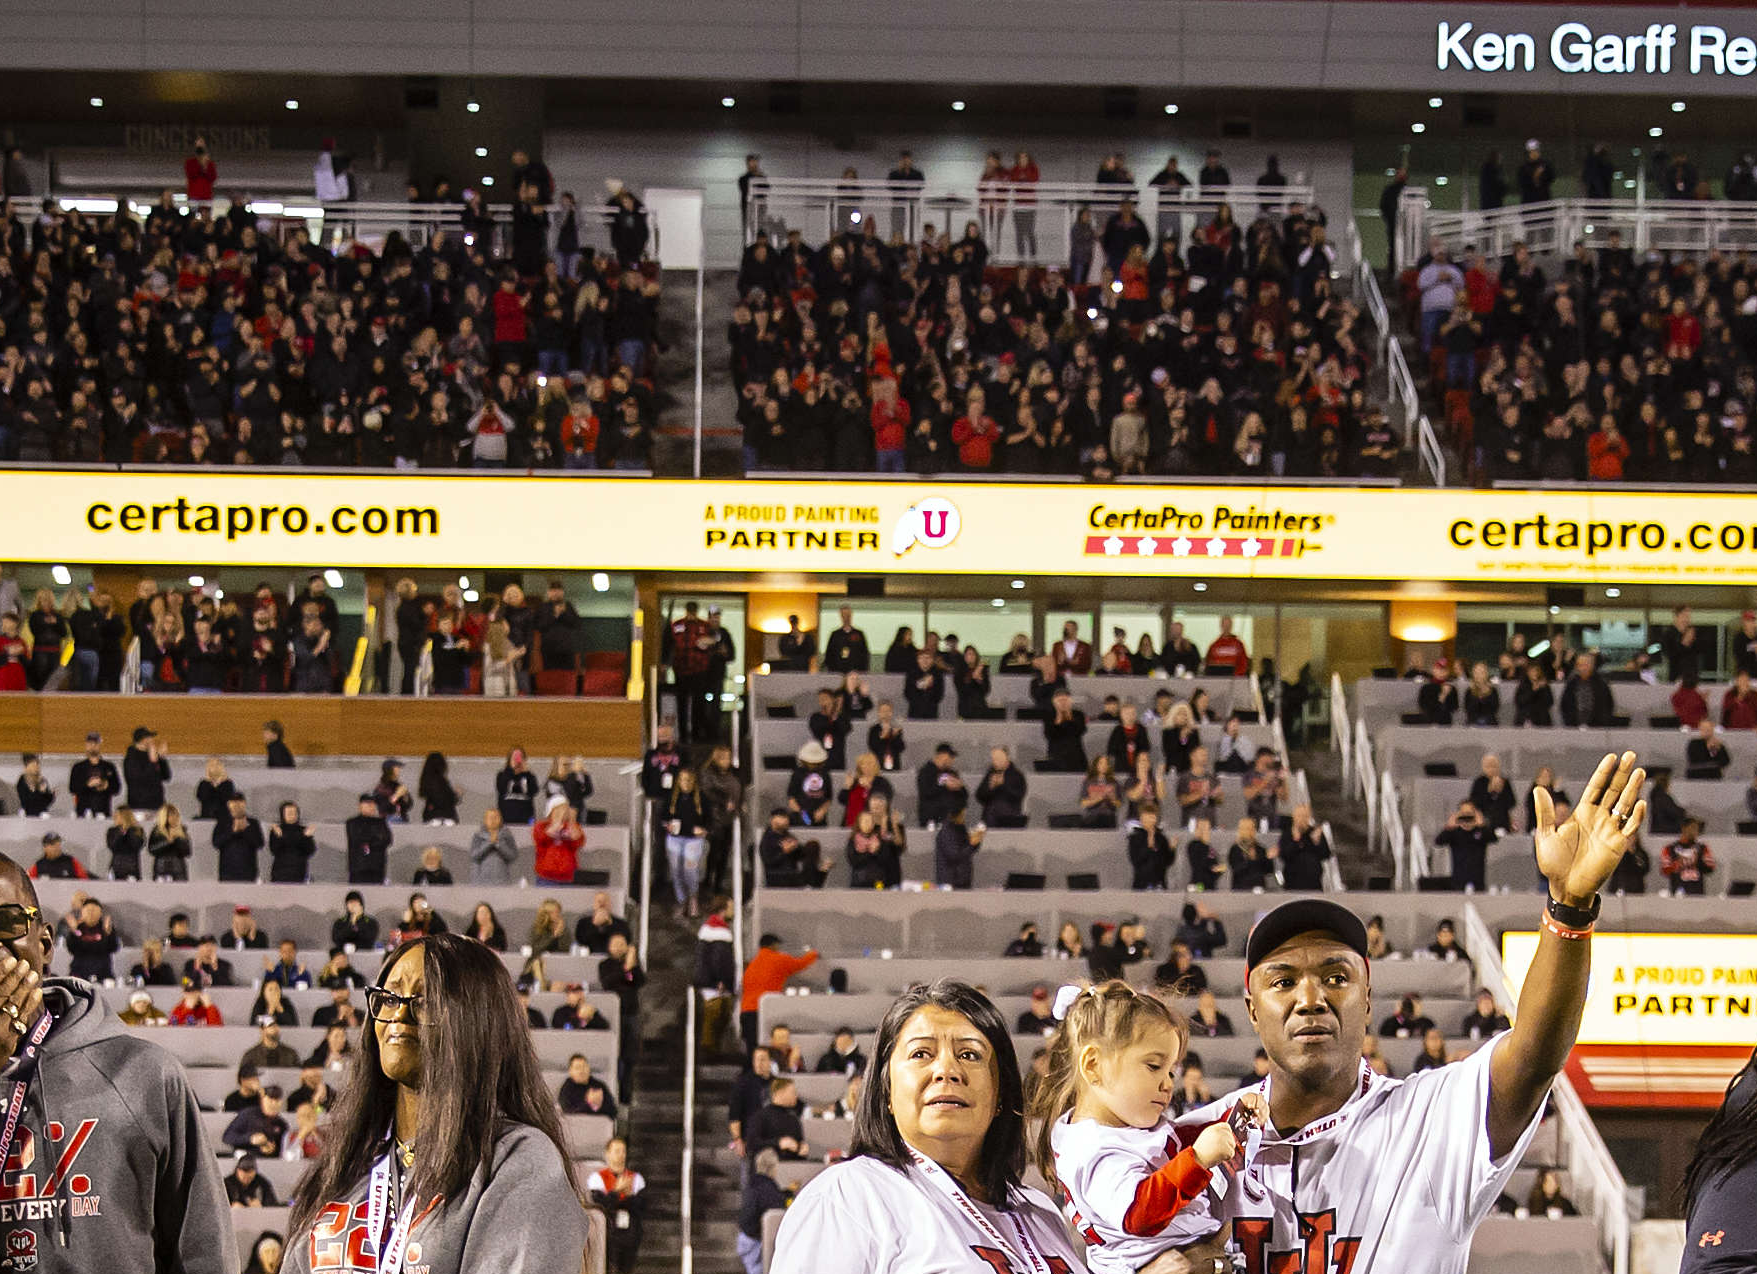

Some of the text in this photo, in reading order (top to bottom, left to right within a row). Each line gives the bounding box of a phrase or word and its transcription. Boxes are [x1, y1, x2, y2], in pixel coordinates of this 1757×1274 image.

[1436, 21, 1535, 73] Ken
[1549, 22, 1677, 75] Garff
[86, 497, 439, 540] certapro.com
[705, 505, 879, 524] A PROUD PAINTING
[922, 510, 949, 538] U
[1090, 504, 1322, 531] CertaPro Painters
[705, 529, 879, 549] PARTNER
[1634, 967, 1704, 985] PROUD
[1, 1195, 101, 1223] EVERY DAY
